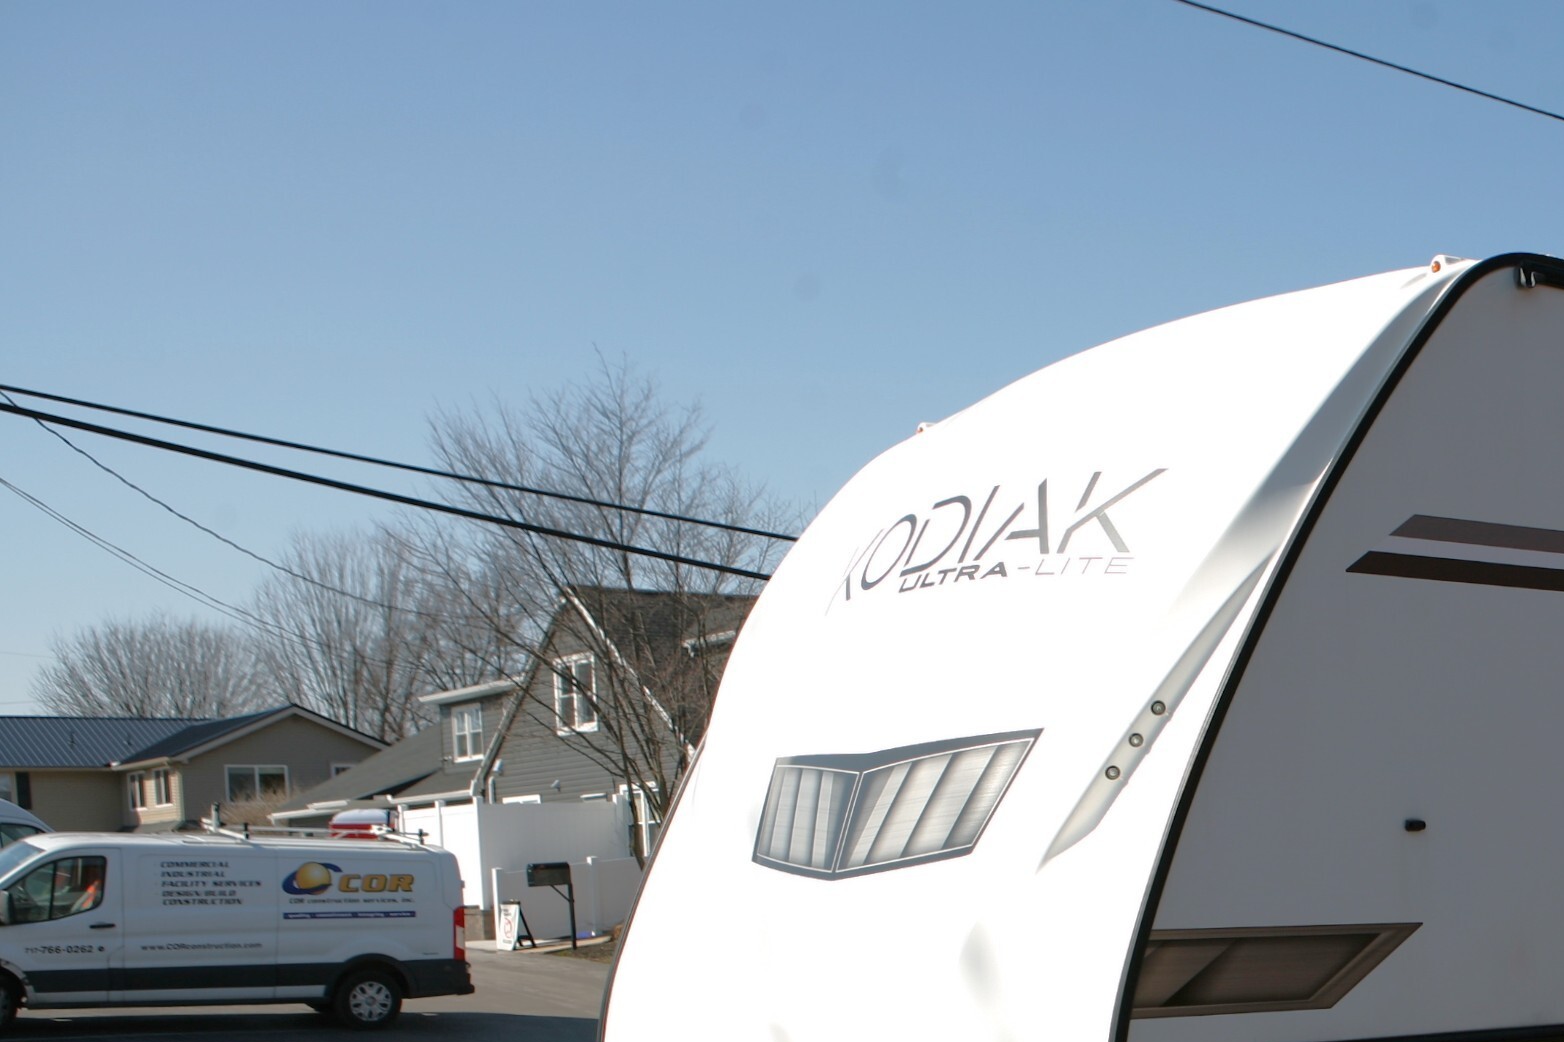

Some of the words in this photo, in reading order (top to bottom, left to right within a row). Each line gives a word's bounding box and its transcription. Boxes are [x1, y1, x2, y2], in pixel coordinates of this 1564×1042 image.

[825, 468, 1168, 616] KODIAK
[898, 556, 1134, 594] ULTRA-LITE
[338, 874, 415, 893] COR
